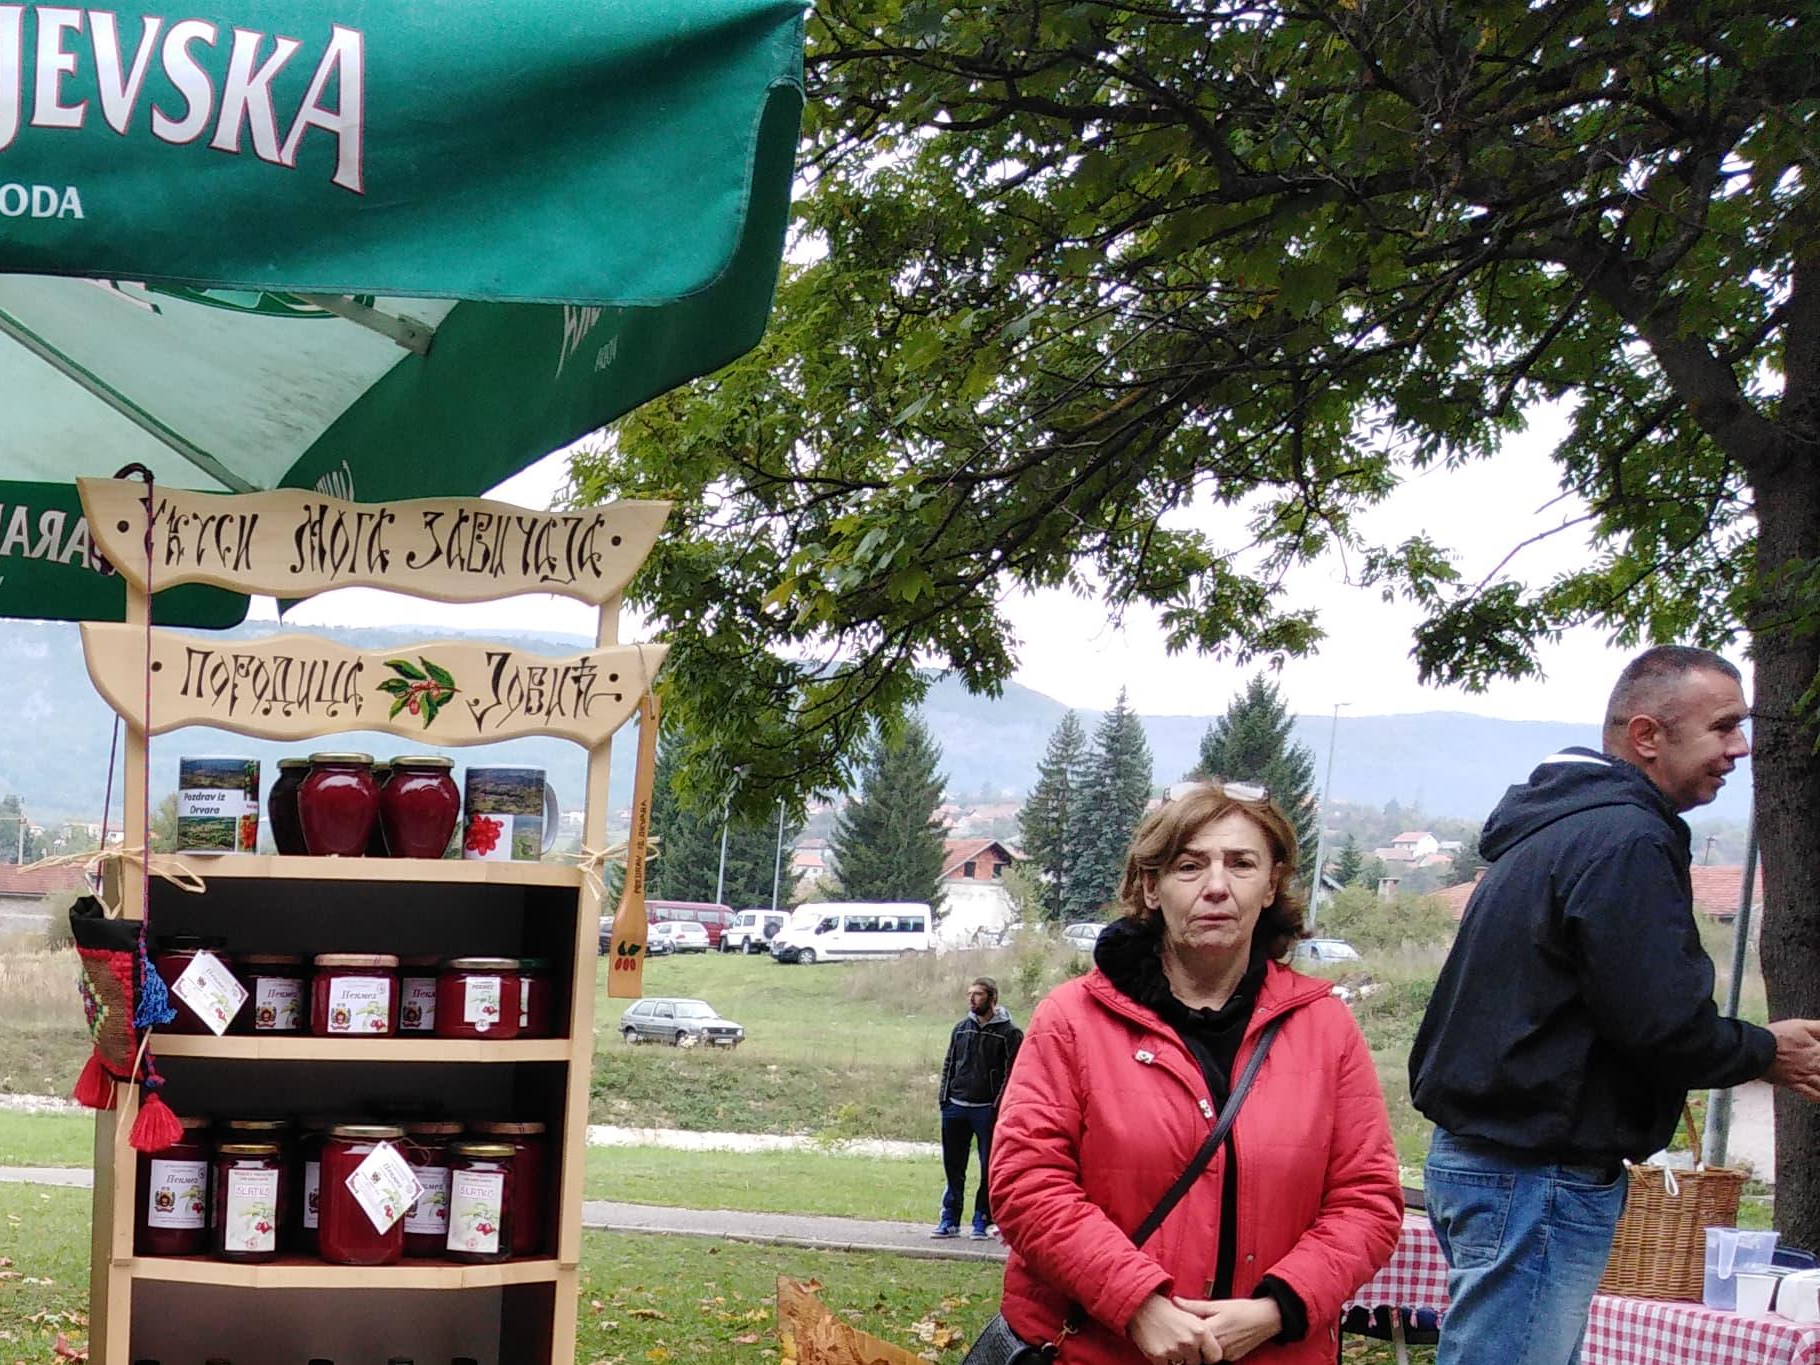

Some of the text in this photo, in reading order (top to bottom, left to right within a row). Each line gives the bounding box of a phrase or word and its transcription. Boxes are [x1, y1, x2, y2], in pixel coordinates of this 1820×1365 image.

[179, 646, 366, 718] ПОРОДИЦА
[183, 792, 216, 801] Pozdrav
[189, 805, 221, 815] Drvara
[340, 990, 378, 1000] Пекмез
